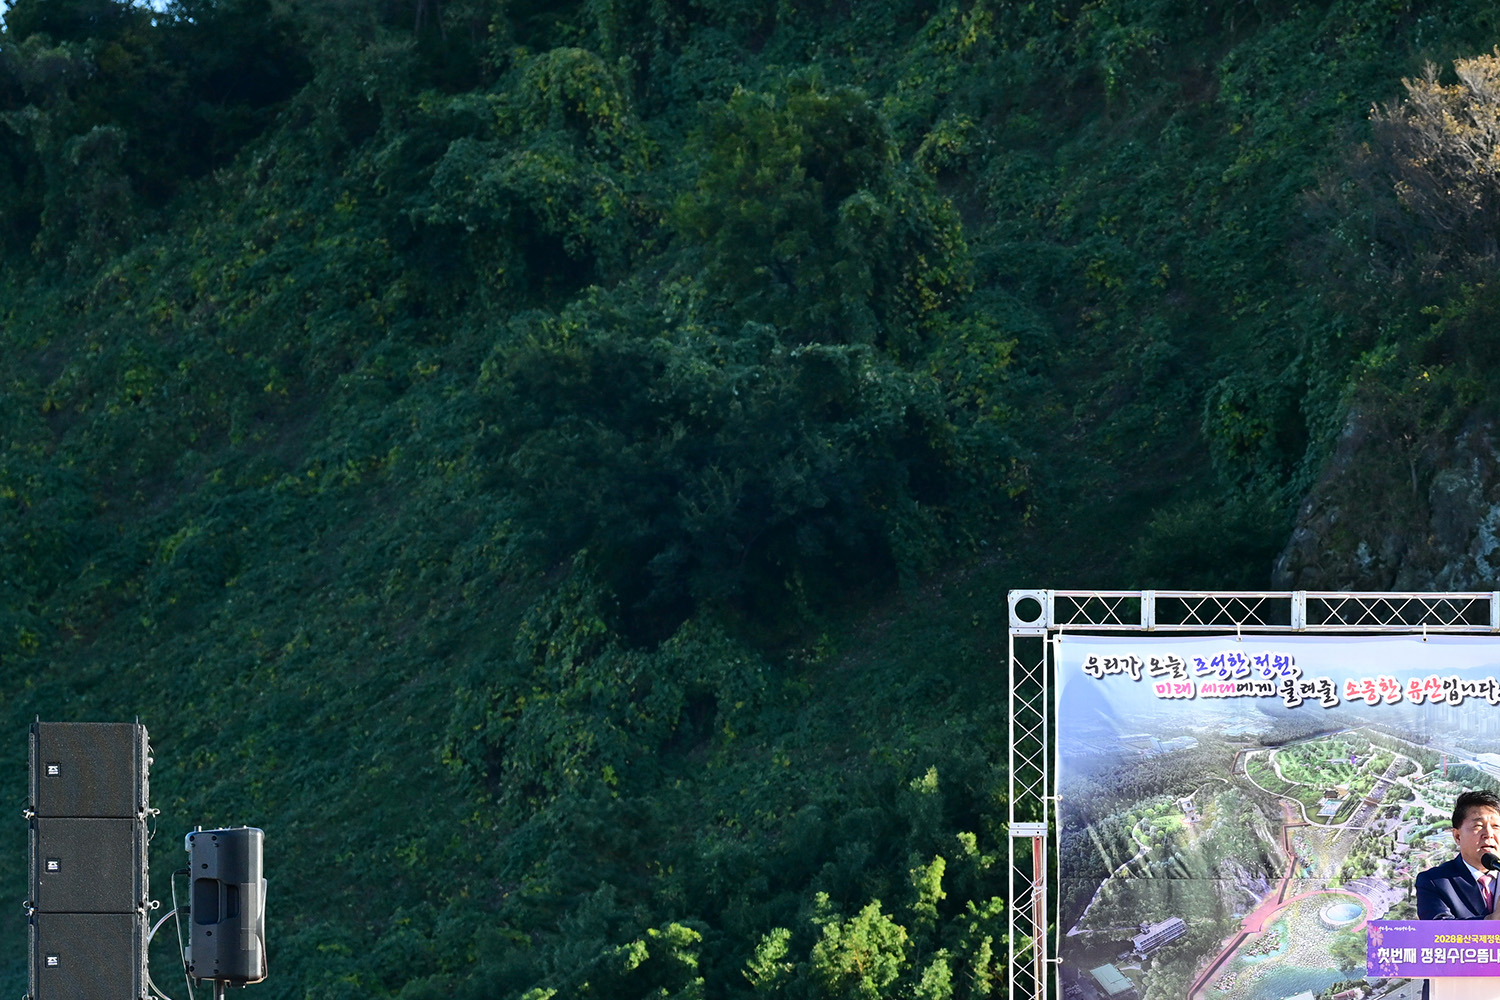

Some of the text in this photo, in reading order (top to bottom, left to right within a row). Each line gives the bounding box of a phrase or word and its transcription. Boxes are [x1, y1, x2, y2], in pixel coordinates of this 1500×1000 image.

[1084, 655, 1139, 677] 우리가
[1149, 655, 1185, 680] 오늘
[1193, 653, 1249, 677] 조성한
[1155, 681, 1192, 696] 미래
[1200, 681, 1273, 695] 세대에게
[1279, 678, 1336, 704] 물려줄
[1345, 677, 1399, 702] 소중한
[1377, 946, 1417, 964] 첫번째
